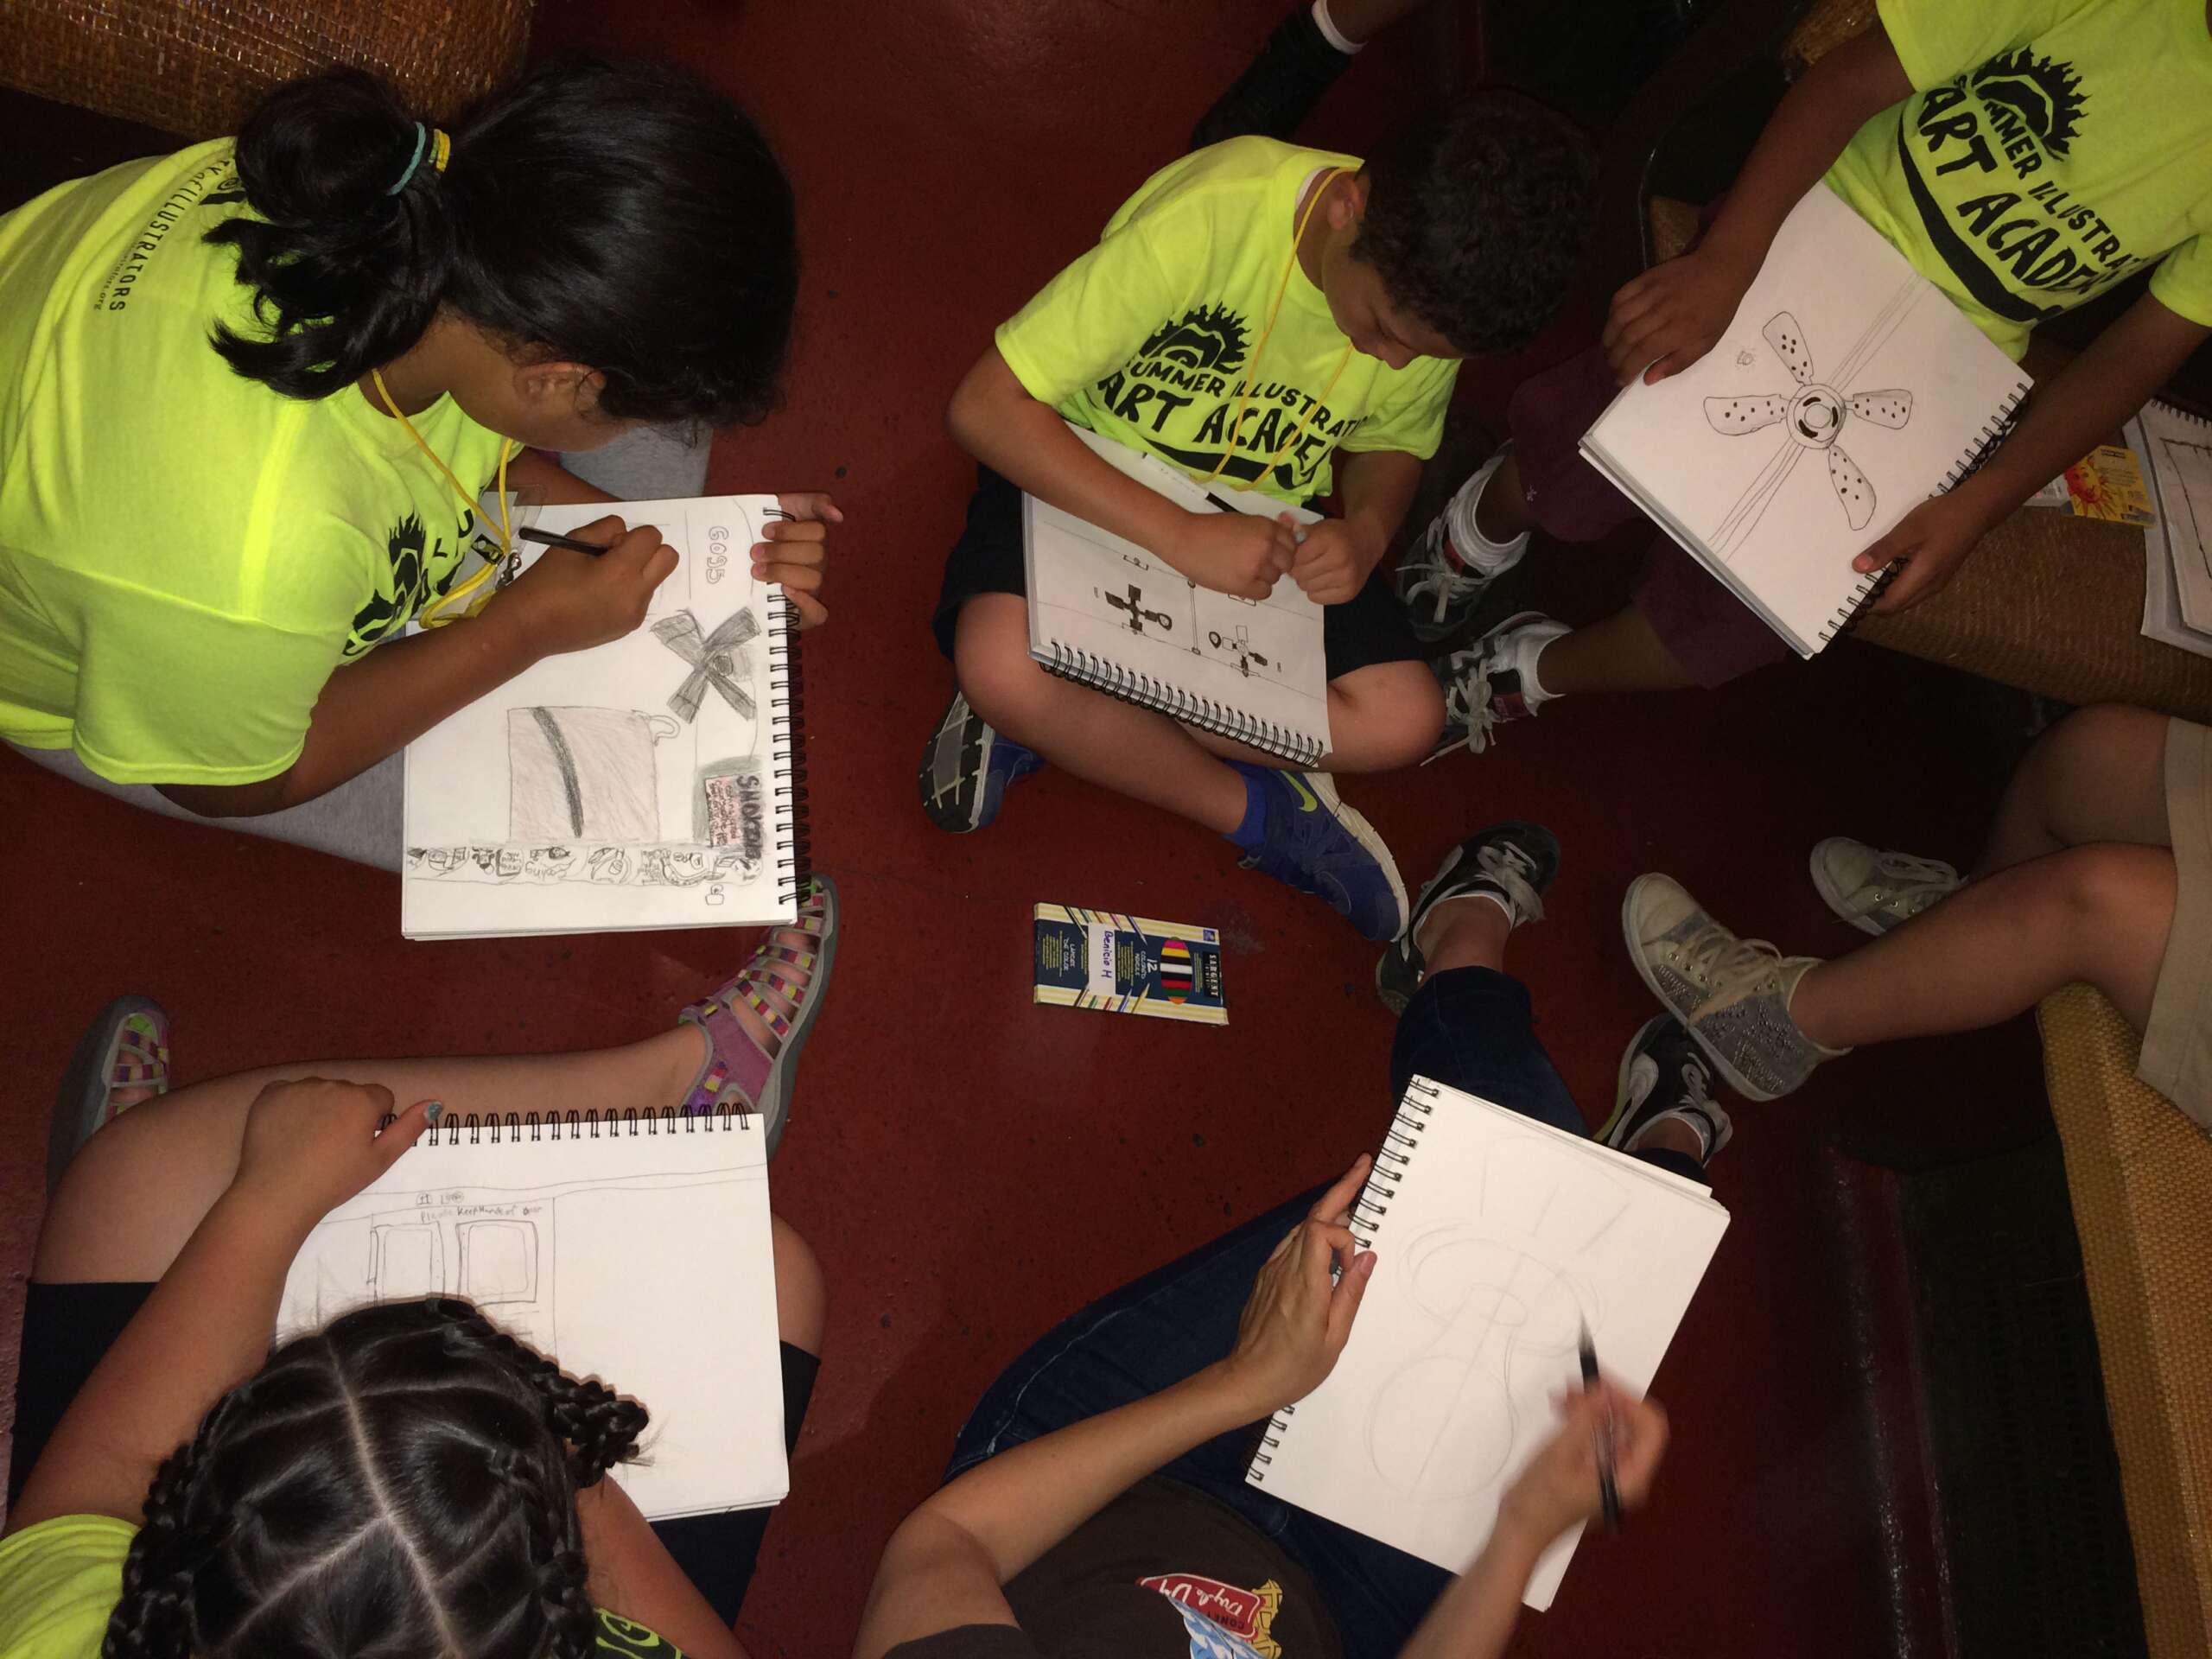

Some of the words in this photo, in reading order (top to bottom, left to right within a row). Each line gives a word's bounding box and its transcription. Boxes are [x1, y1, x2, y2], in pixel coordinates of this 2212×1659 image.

[1917, 87, 1998, 176] ART
[109, 188, 199, 311] ILLUSTRATORS
[1125, 356, 1226, 398] UMMER
[1097, 370, 1194, 433] ART
[1103, 931, 1114, 966] Benicio
[1147, 959, 1158, 972] 12
[1101, 969, 1112, 979] H
